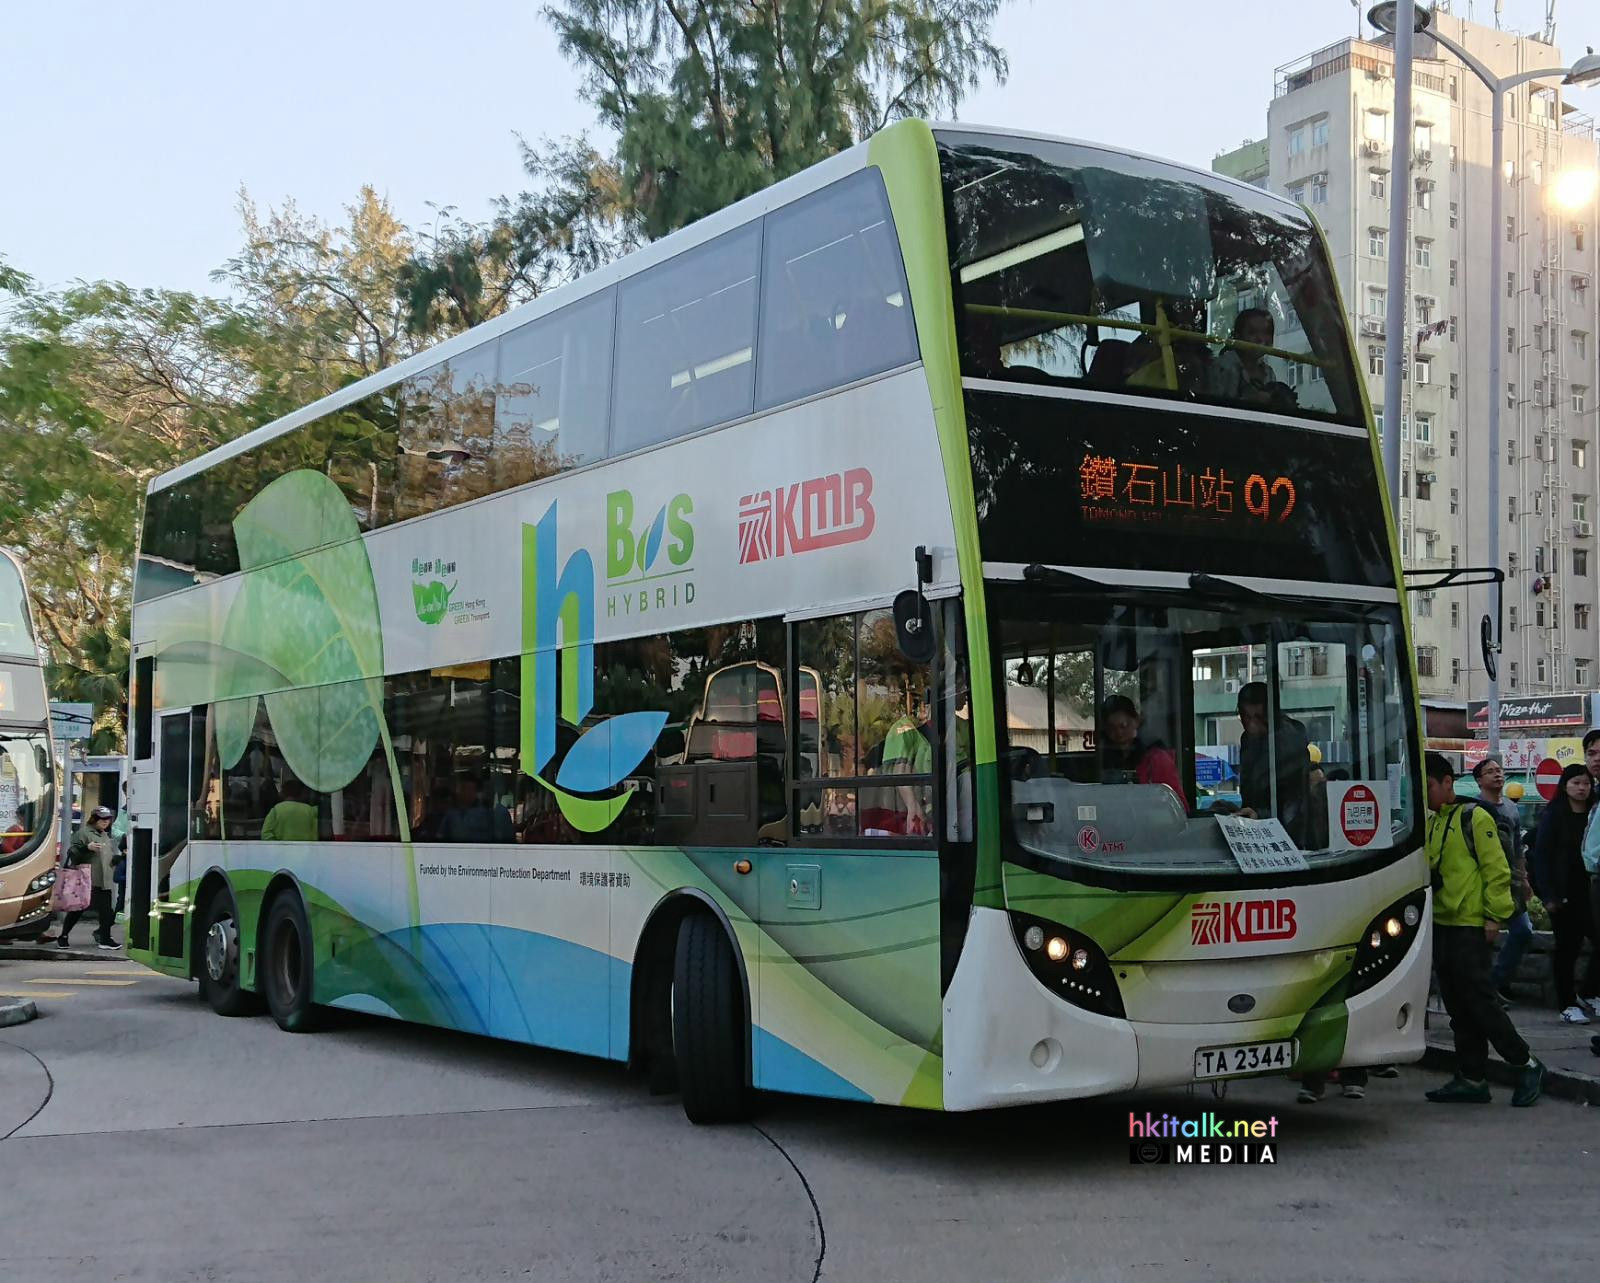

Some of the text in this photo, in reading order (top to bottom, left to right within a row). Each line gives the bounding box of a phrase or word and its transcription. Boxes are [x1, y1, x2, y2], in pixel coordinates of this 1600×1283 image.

[1079, 454, 1234, 513] 鑽石山站
[1244, 474, 1296, 521] 92
[775, 467, 876, 558] KMB
[606, 582, 696, 618] HYBRID
[1499, 701, 1552, 718] Pizza Hut
[420, 864, 571, 882] Funded by the Environmental Protection Department
[579, 872, 631, 888] 環境保護署資助
[1223, 898, 1297, 944] KMB
[1202, 1045, 1285, 1073] TA 2344
